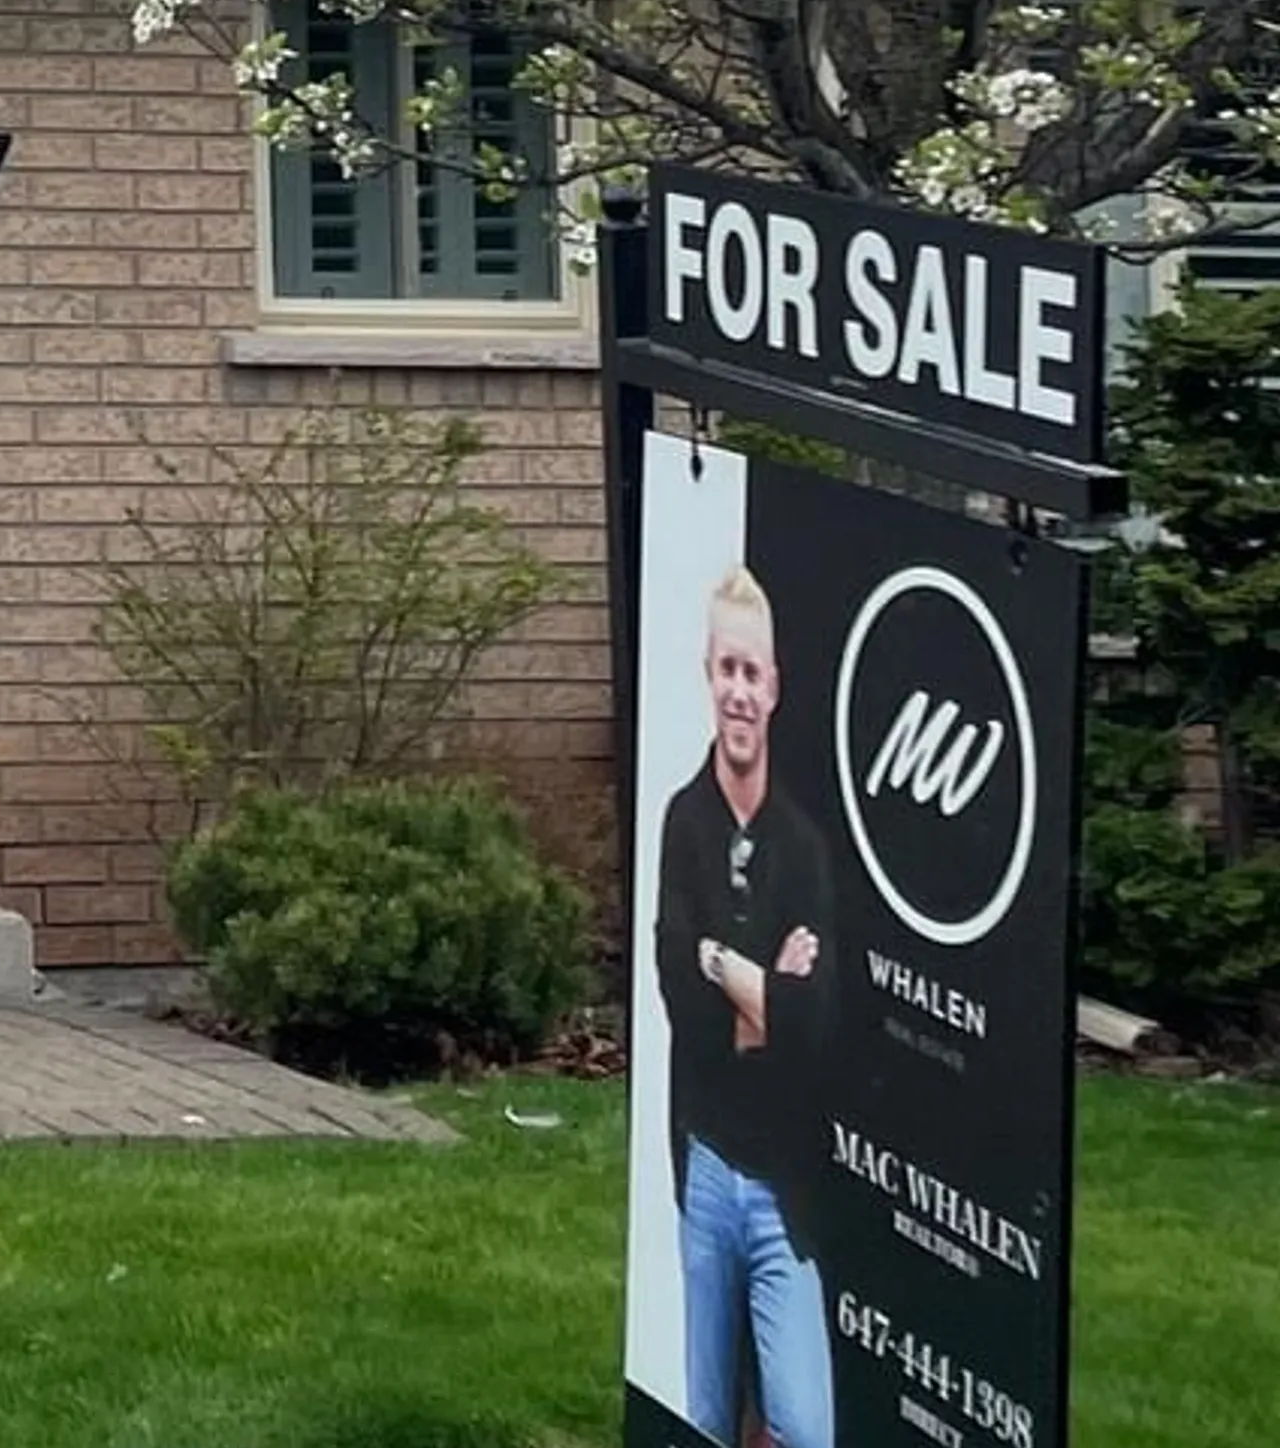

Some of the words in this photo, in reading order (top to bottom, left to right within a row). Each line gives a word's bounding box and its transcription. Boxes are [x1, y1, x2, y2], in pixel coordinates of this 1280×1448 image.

[665, 192, 819, 358] FOR
[844, 231, 1077, 426] SALE
[866, 949, 987, 1039] WHALEN
[833, 1122, 900, 1196] MAC
[906, 1164, 1042, 1280] WHALEN
